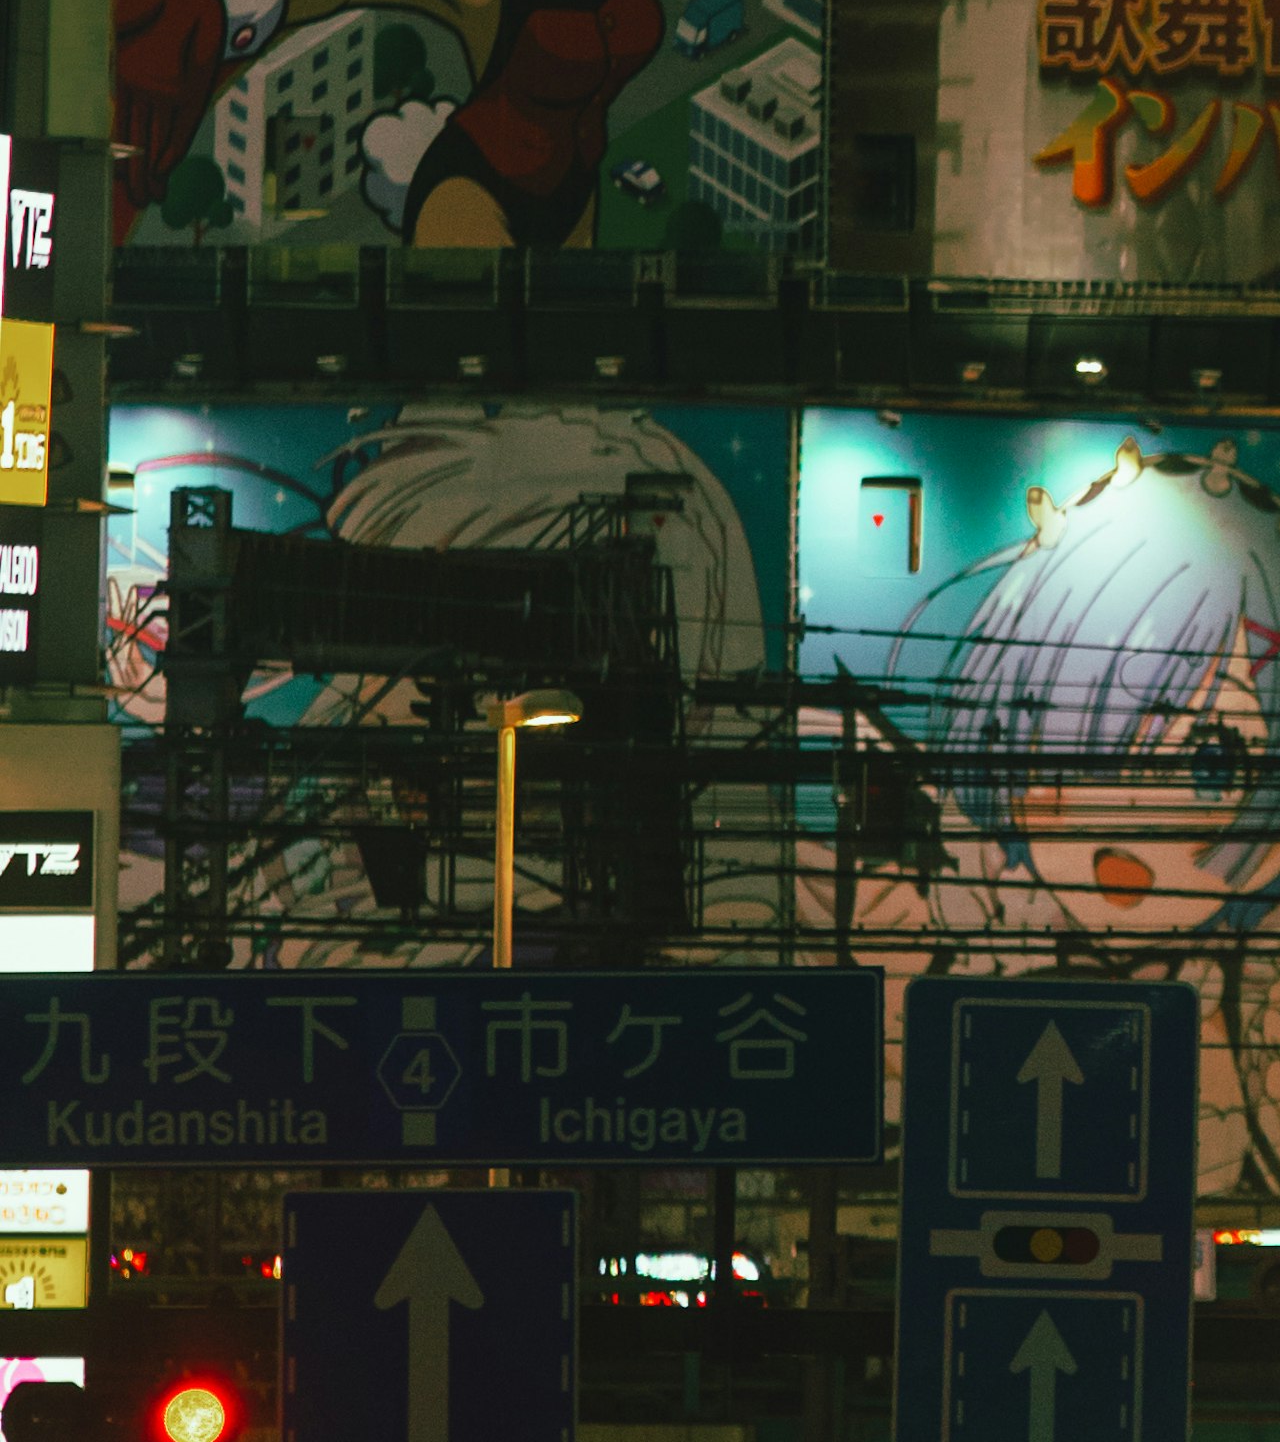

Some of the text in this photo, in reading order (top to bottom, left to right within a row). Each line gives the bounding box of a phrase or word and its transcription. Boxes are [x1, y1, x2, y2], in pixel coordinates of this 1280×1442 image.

[21, 994, 358, 1086] 九段下
[401, 1047, 433, 1095] 4
[46, 1100, 329, 1147] Kudanshita
[540, 1097, 747, 1152] Ichigaya
